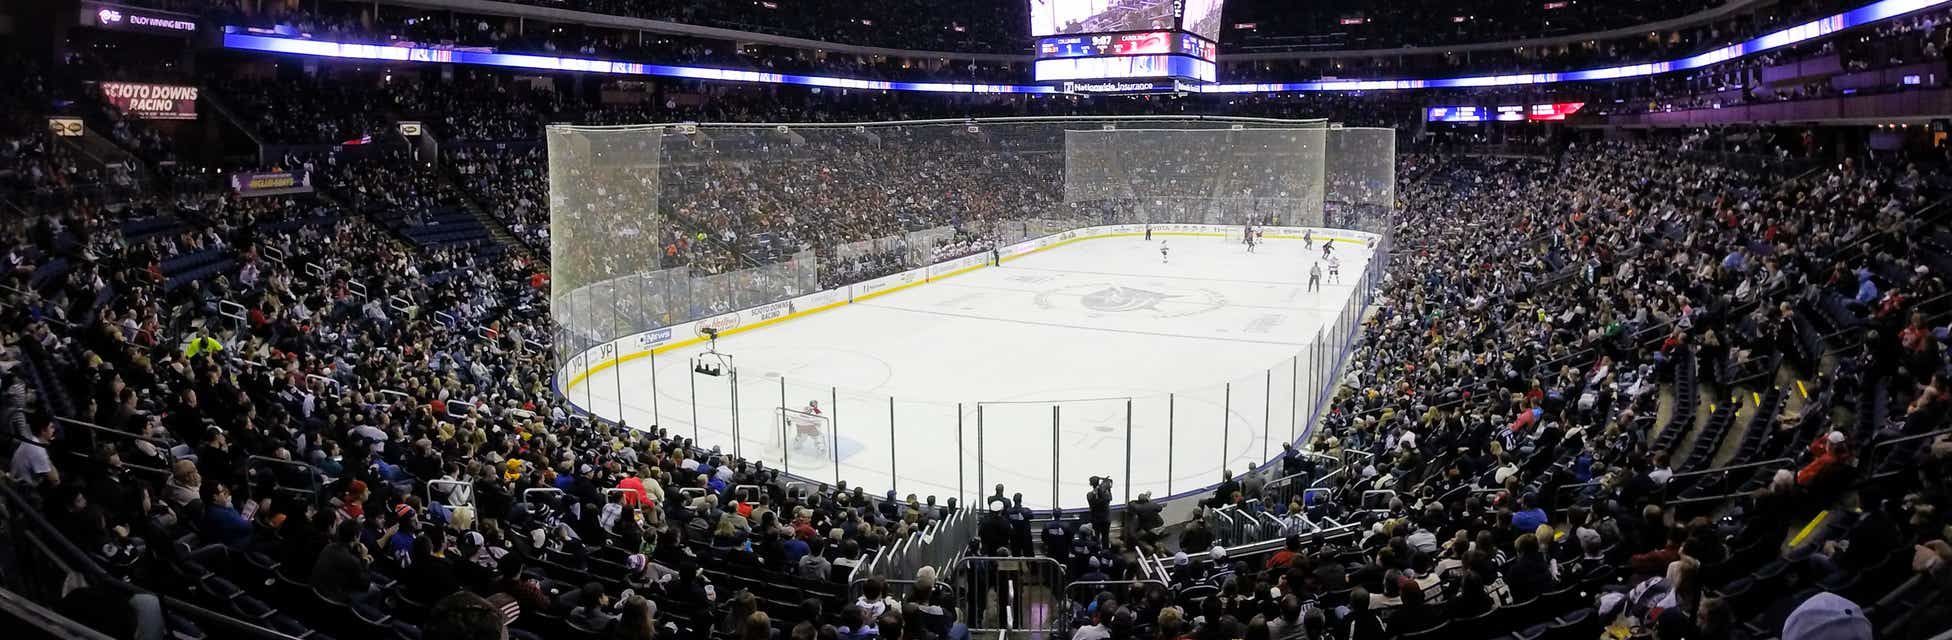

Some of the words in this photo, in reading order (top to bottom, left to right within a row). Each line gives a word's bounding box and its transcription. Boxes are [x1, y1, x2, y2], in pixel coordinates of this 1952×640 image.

[130, 15, 150, 25] ENJOY
[150, 18, 174, 29] WINNING
[174, 20, 196, 31] BETTER
[103, 82, 150, 99] SCIOTO
[151, 84, 198, 101] DOWNS
[1074, 83, 1117, 93] Nationwide
[1117, 81, 1154, 91] Insurance
[128, 98, 173, 112] RACINO
[600, 343, 613, 359] yp
